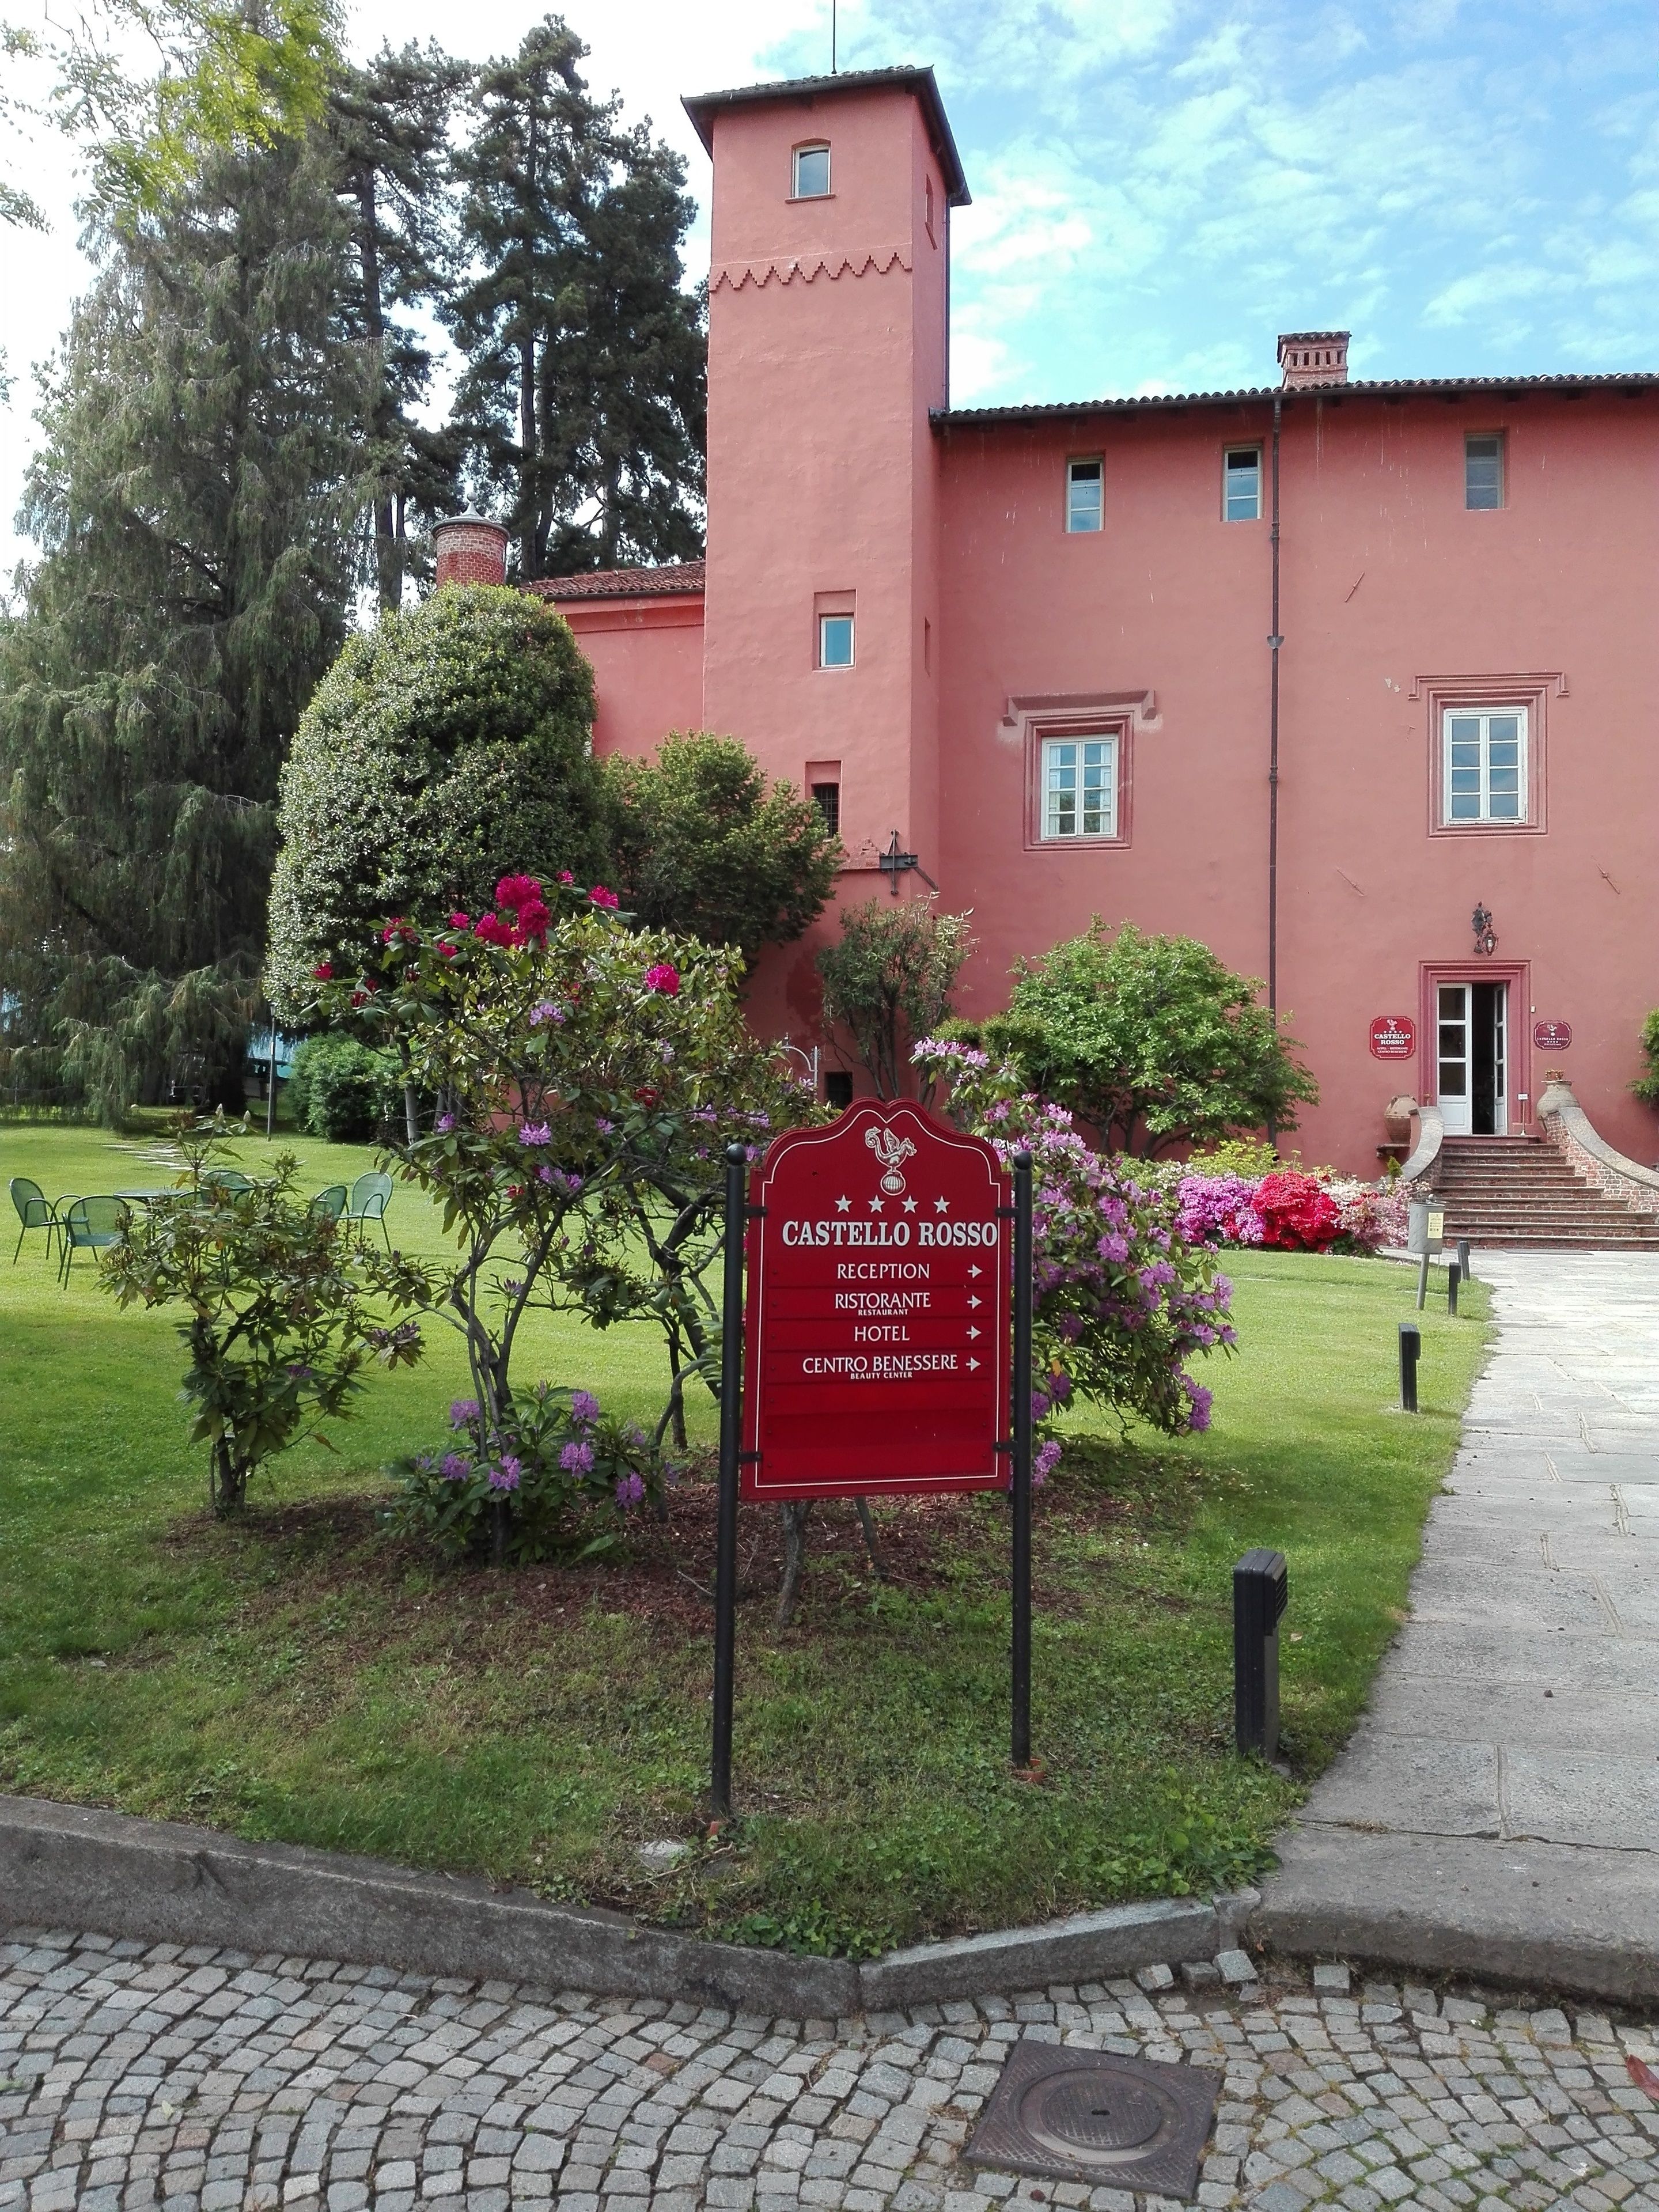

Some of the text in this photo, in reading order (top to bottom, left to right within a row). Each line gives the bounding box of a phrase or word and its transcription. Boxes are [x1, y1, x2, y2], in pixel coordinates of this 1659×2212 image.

[783, 1221, 998, 1247] CASTELLO ROSSO
[838, 1263, 930, 1279] RECEPTION
[835, 1292, 931, 1309] RISTORANTE
[854, 1325, 910, 1342] HOTEL
[802, 1354, 959, 1373] CENTRO BENESSERE
